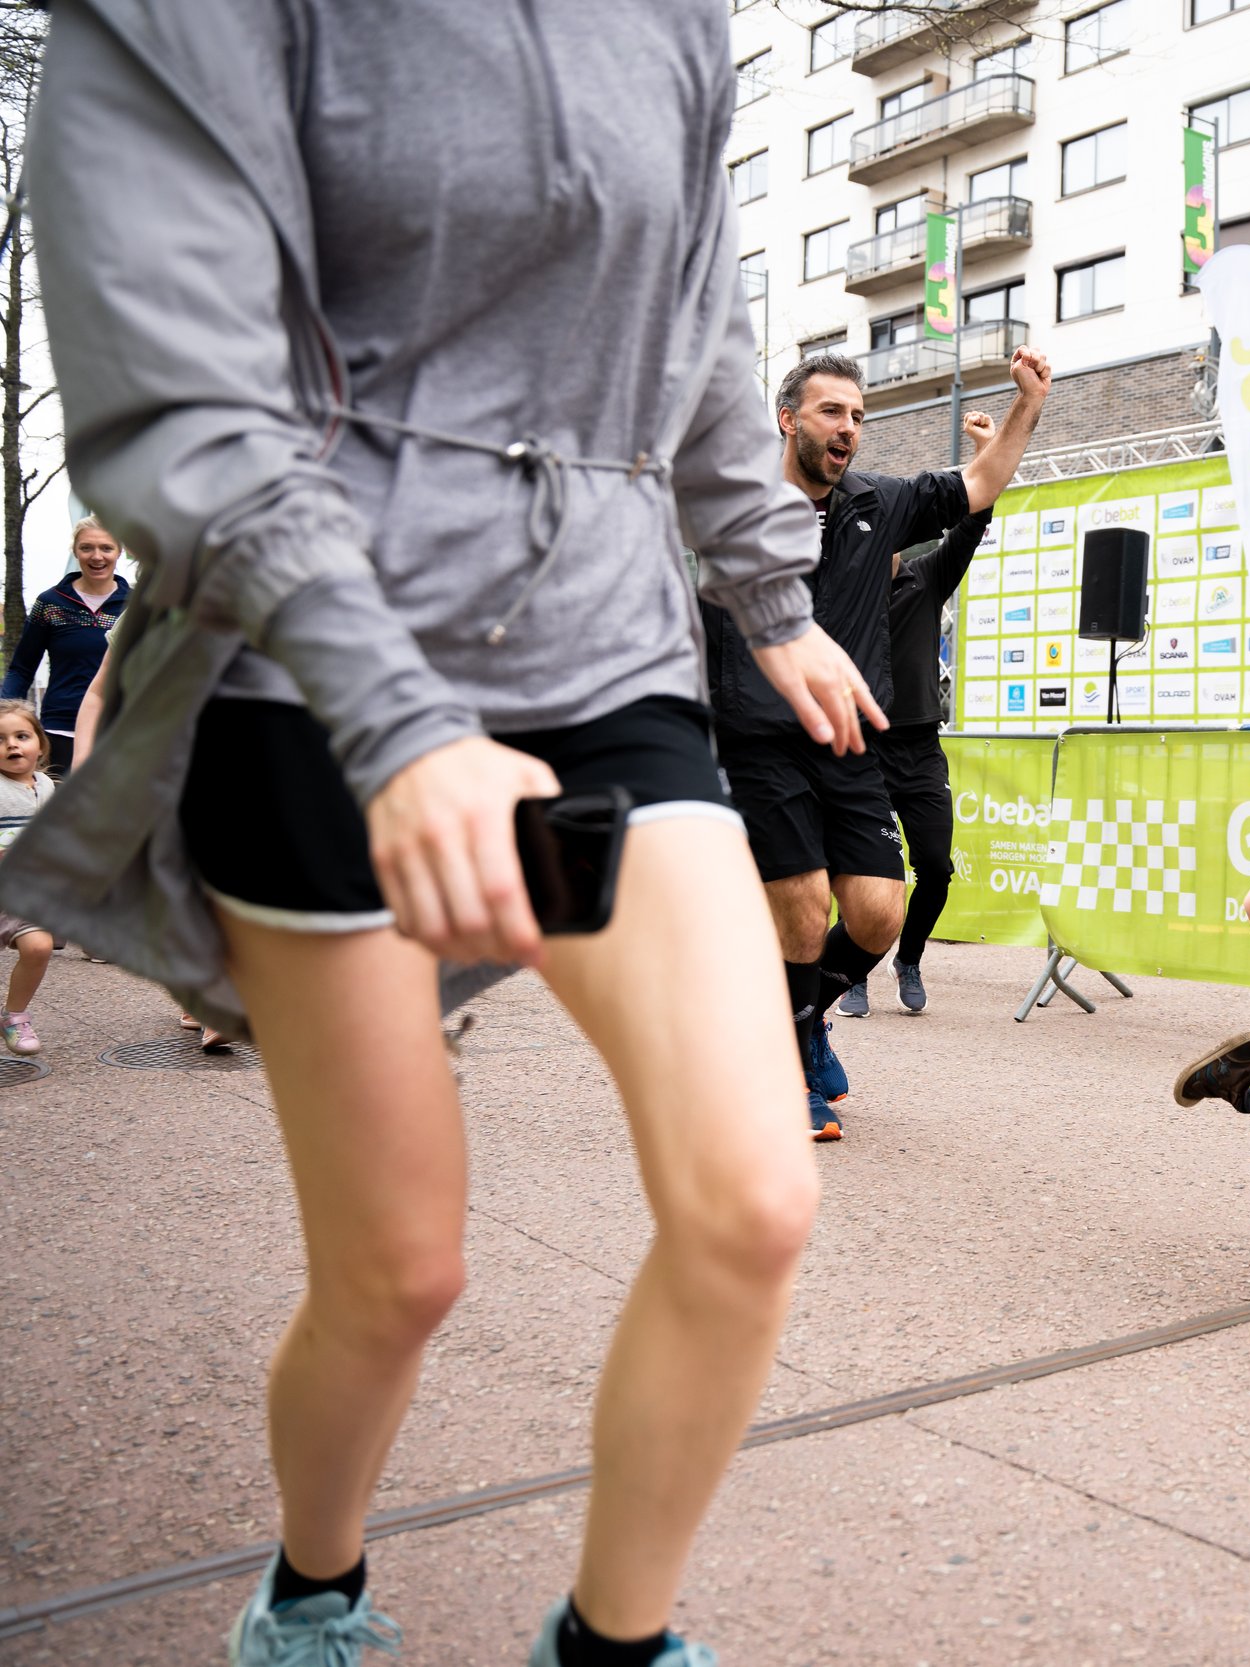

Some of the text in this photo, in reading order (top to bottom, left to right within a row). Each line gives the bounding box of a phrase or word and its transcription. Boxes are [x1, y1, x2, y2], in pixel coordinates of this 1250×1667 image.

[1105, 504, 1141, 523] bebat
[1160, 652, 1188, 660] SCANIA
[984, 794, 1051, 827] beba
[990, 840, 1017, 850] SAMEN
[990, 851, 1025, 862] MORGEN
[990, 868, 1042, 895] OVA
